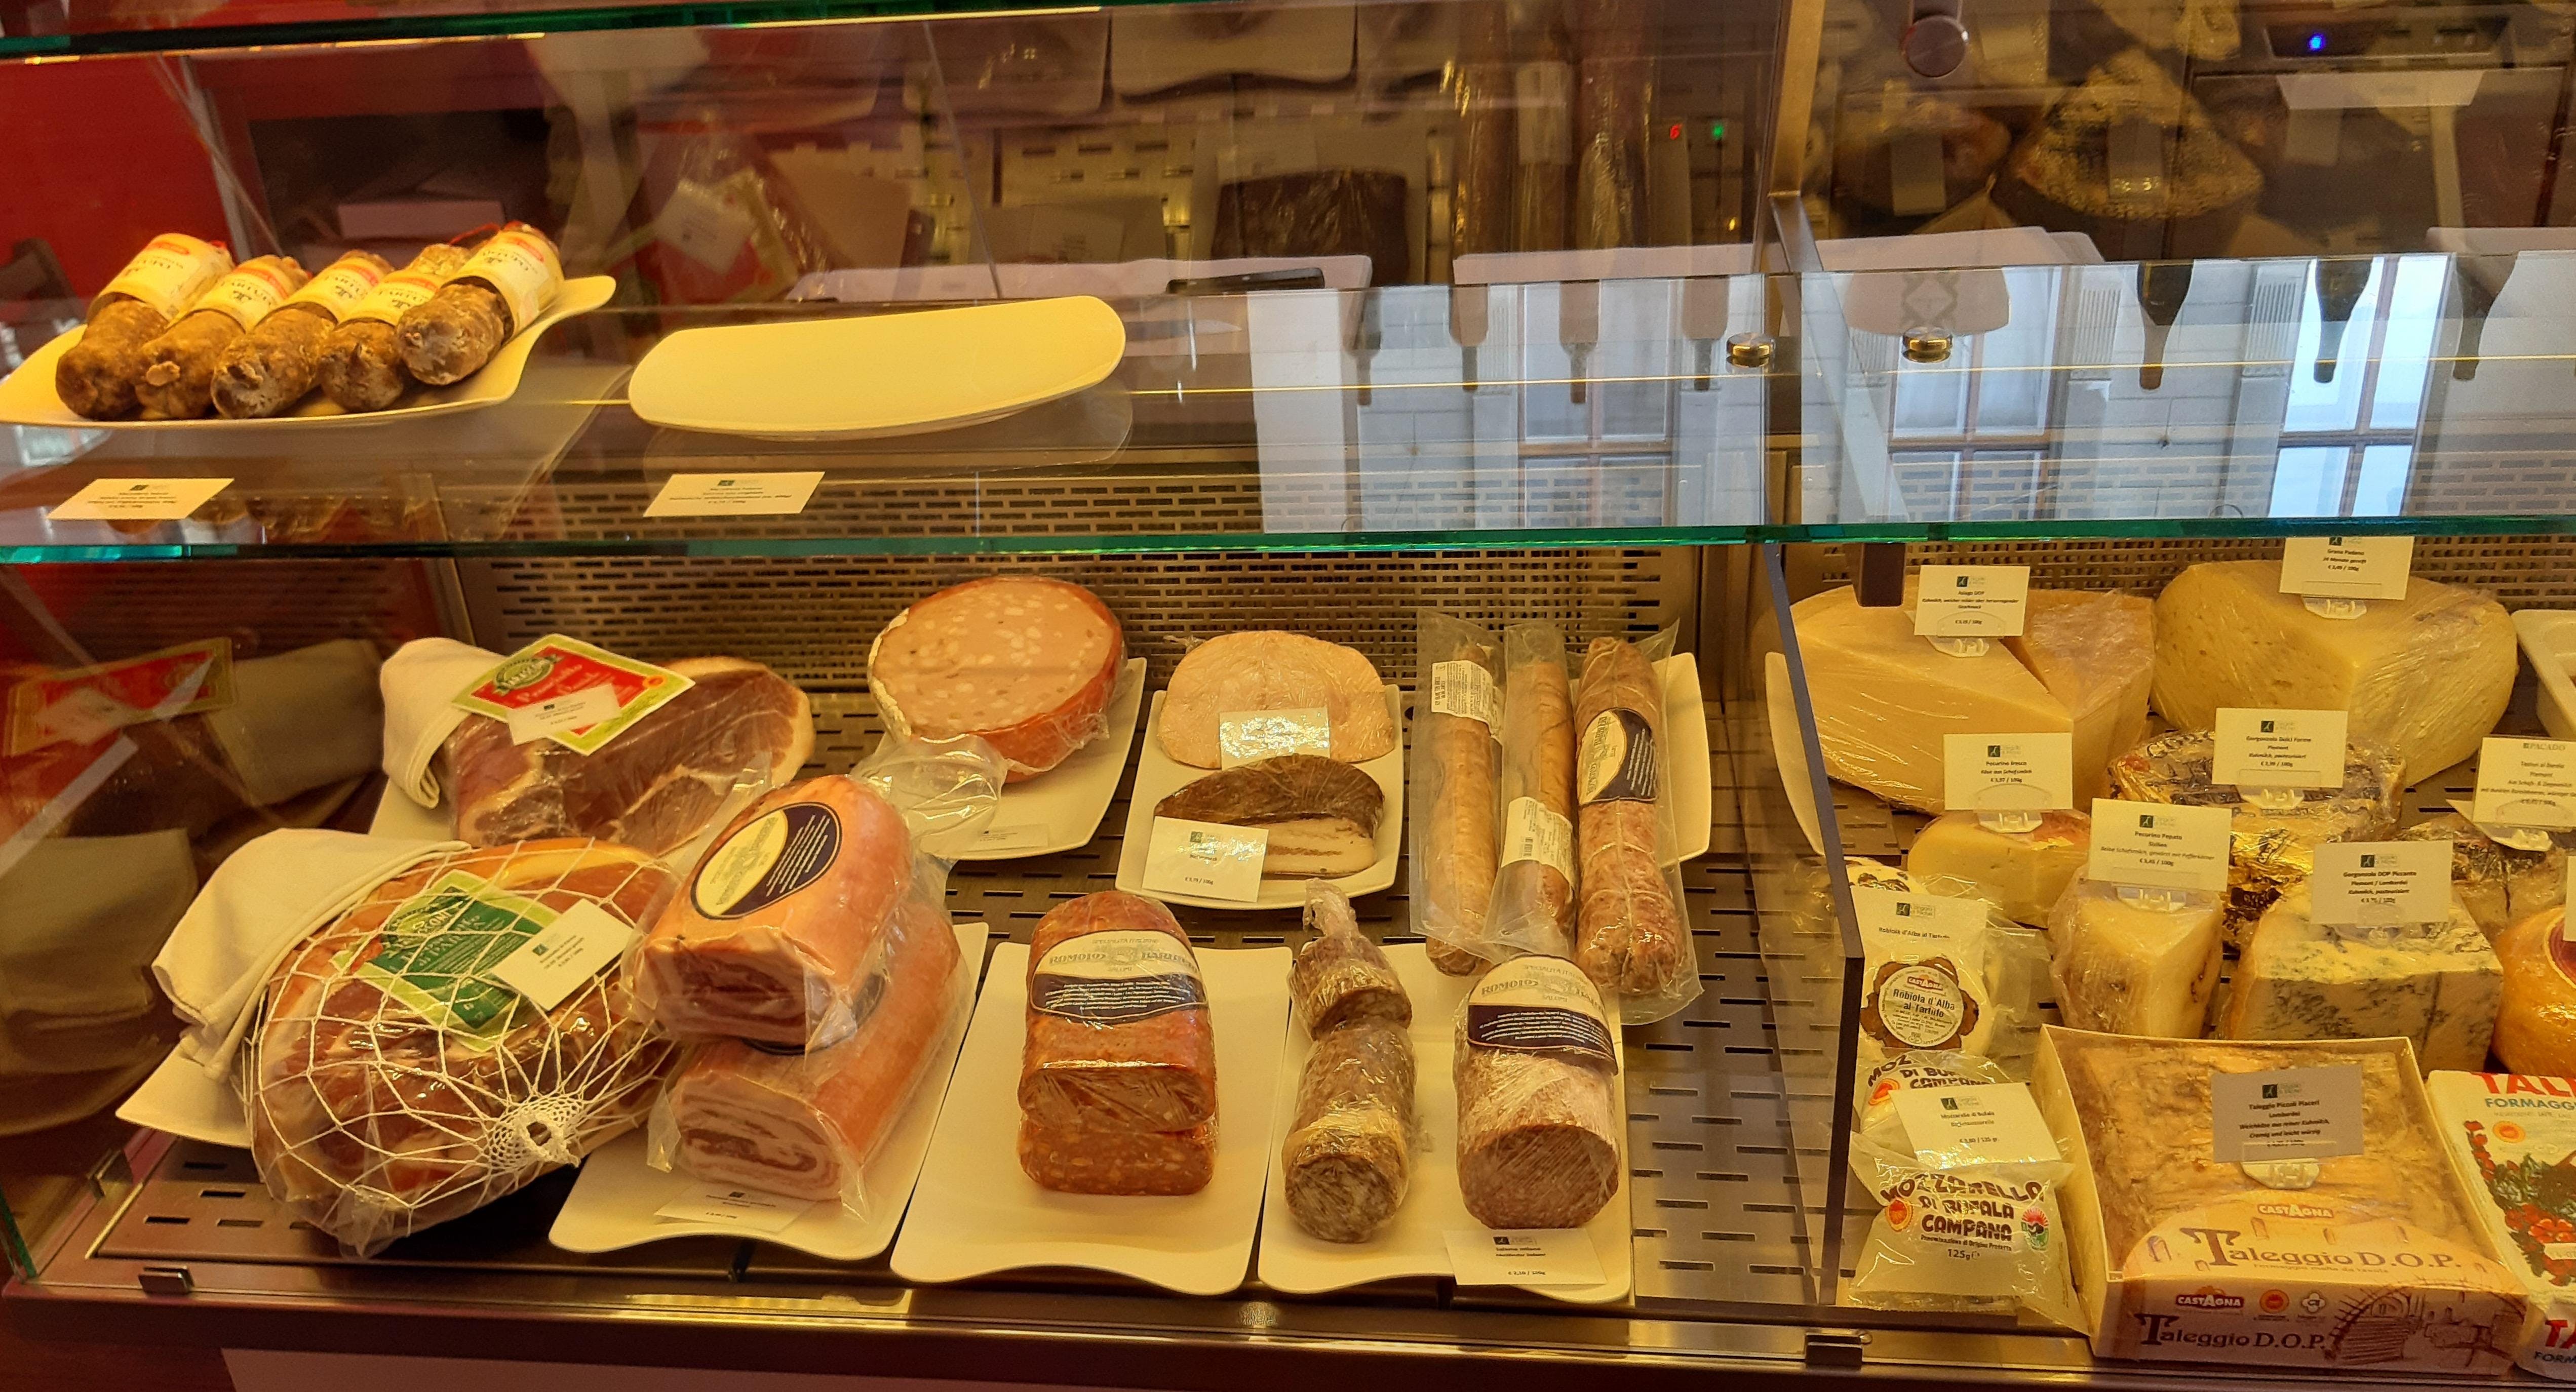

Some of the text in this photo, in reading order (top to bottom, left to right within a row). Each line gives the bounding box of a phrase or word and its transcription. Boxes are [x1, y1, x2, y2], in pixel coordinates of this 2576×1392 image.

[1893, 989, 1955, 1011] Robiola d'Alba
[1900, 1068, 1919, 1079] DI
[1880, 1173, 2046, 1202] MOZZARELLA
[1917, 1195, 2015, 1219] DI BUFALA
[2258, 1204, 2333, 1218] CASTAGNA
[1922, 1214, 2013, 1242] CAMPANA
[1947, 1248, 1971, 1261] 125g
[2179, 1227, 2462, 1267] Taleggio D.O.P.
[2178, 1294, 2242, 1307] CASTAGNA
[2134, 1313, 2326, 1349] Taleggio D.O.P.
